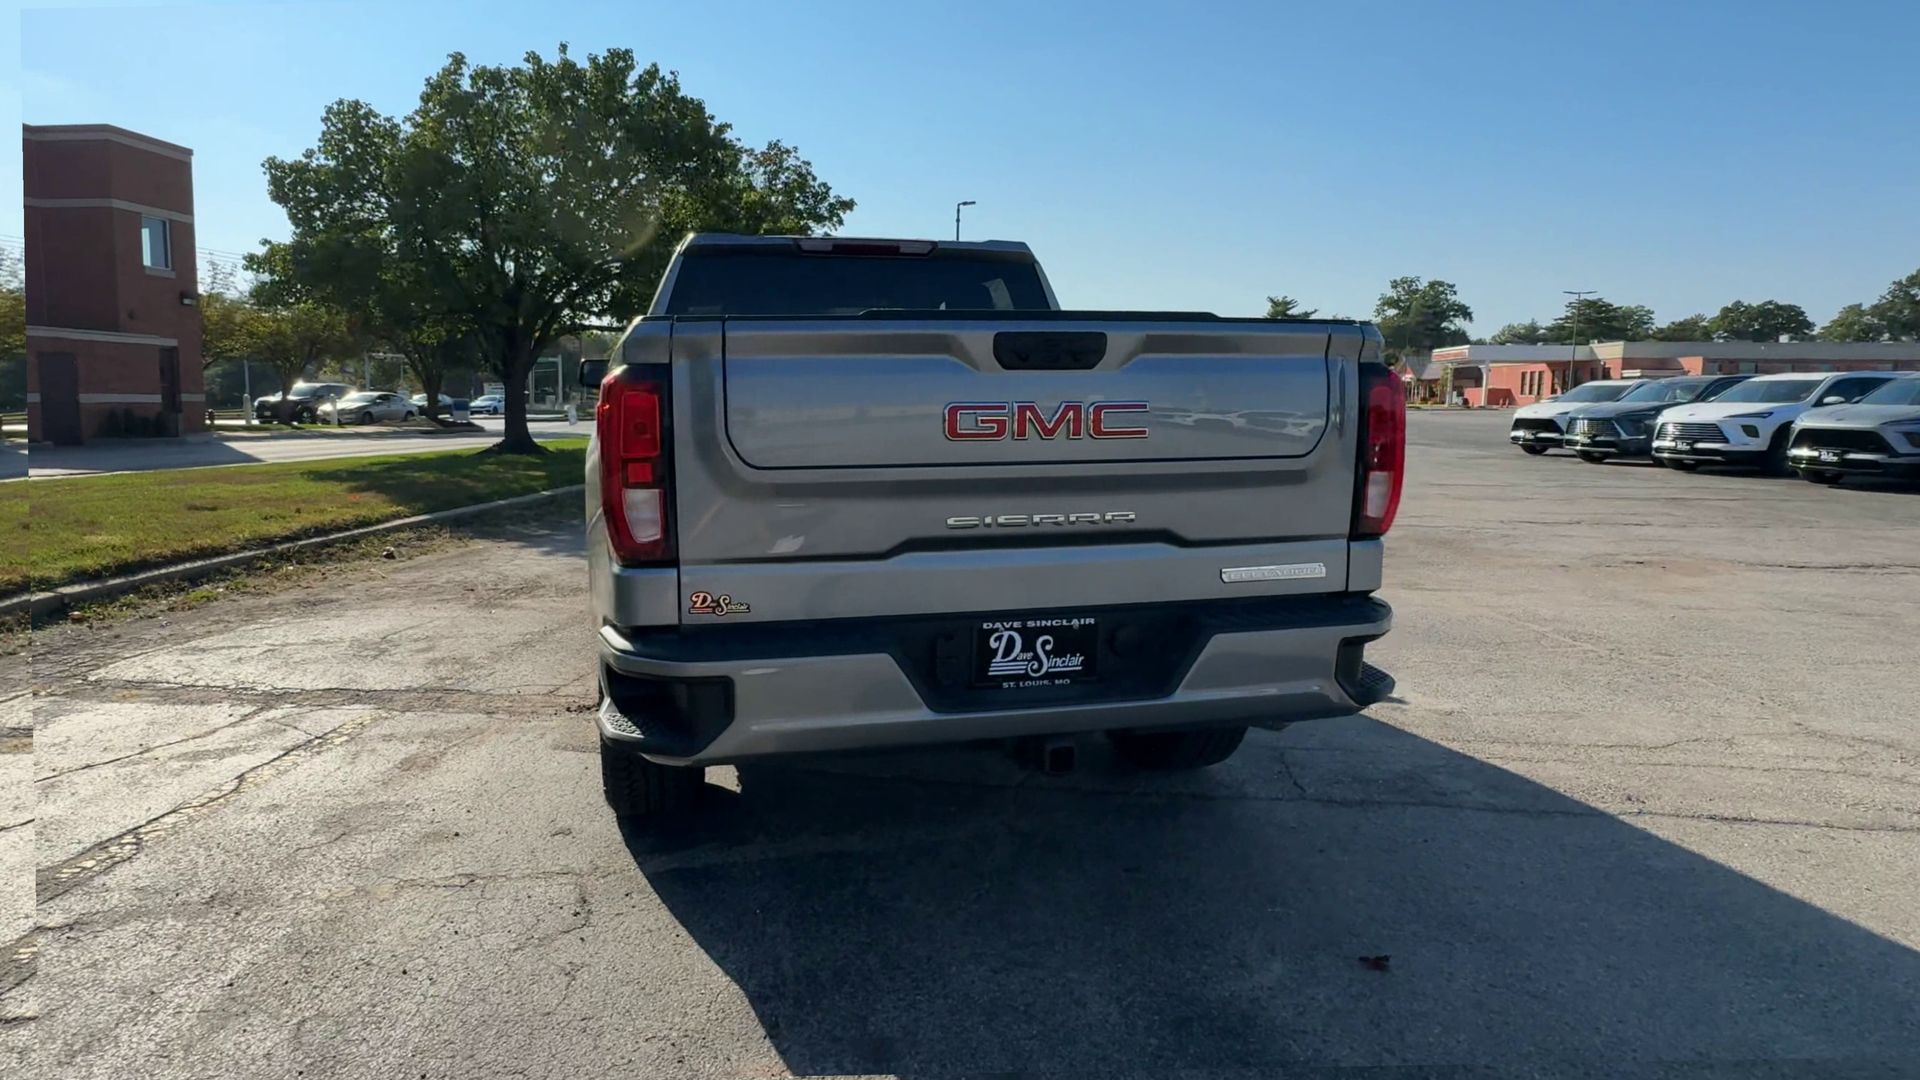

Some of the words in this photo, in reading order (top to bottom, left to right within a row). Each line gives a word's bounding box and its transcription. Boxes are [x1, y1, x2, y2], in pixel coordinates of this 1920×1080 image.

[944, 401, 1149, 440] GMC
[946, 511, 1136, 528] SIERRA
[983, 621, 1022, 629] DAVE
[1026, 618, 1095, 627] SINCLAIR
[989, 630, 1034, 662] Dave
[1027, 635, 1084, 677] Sinclair
